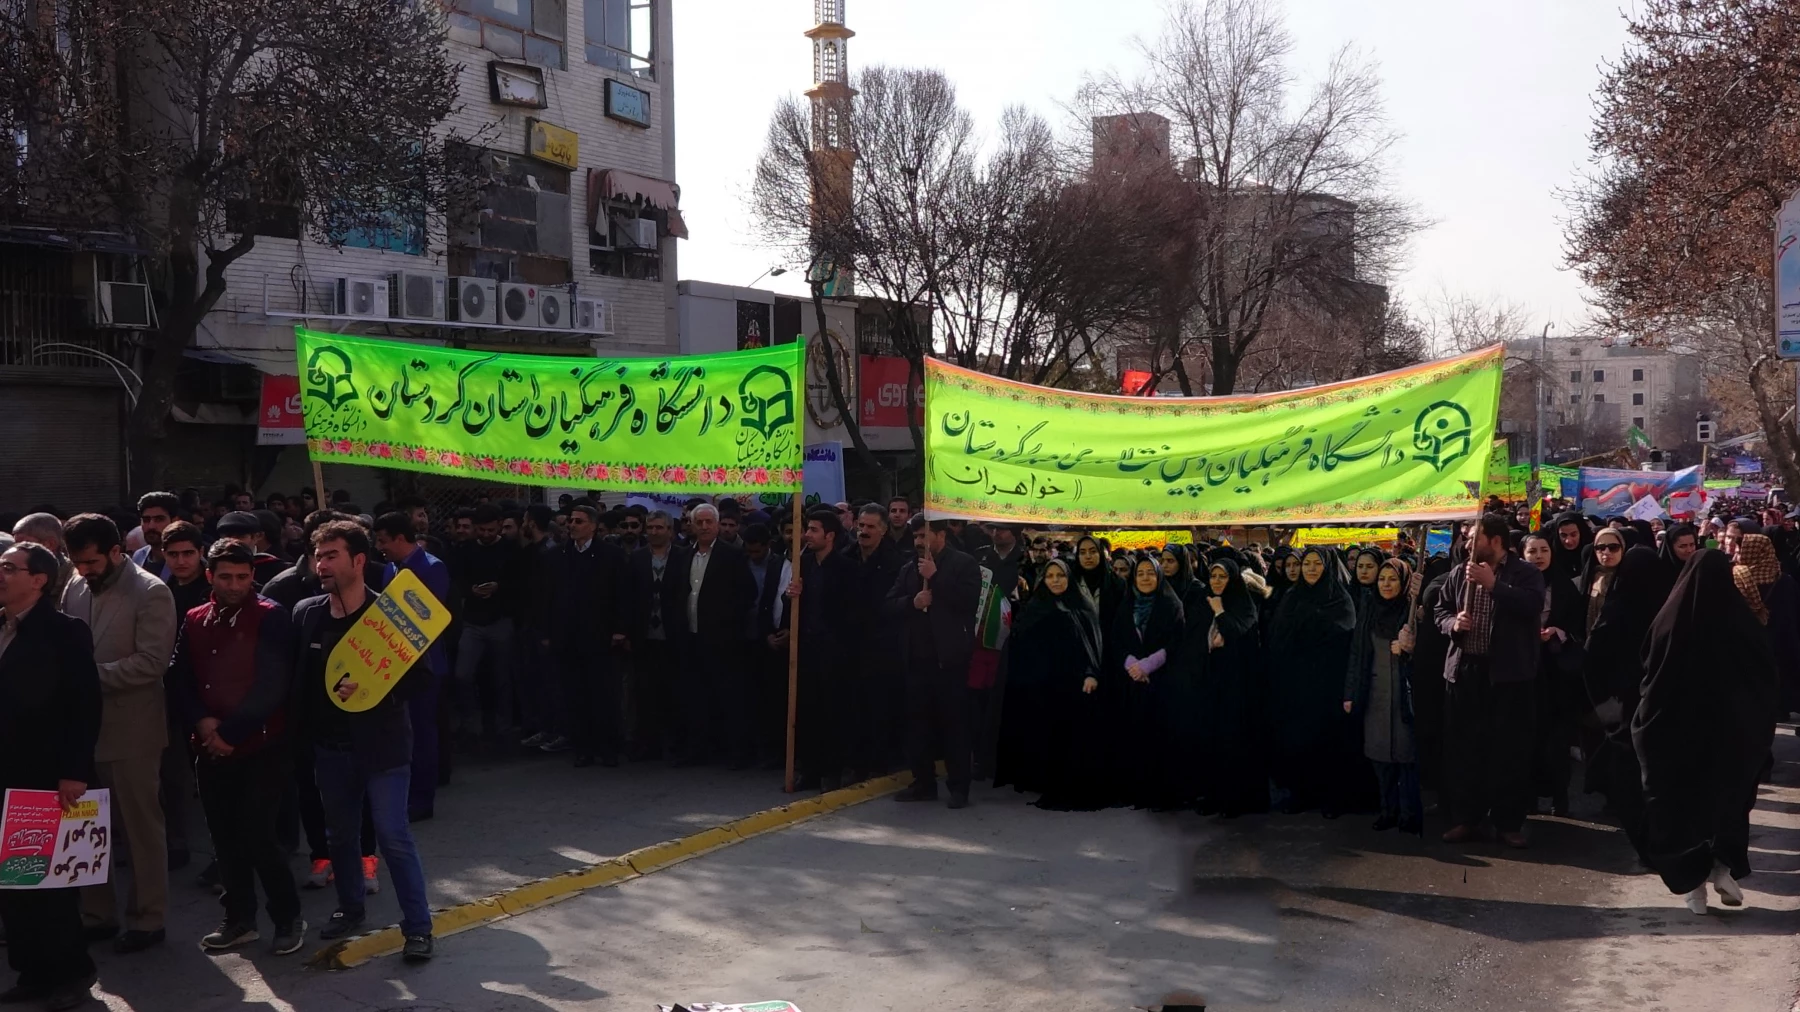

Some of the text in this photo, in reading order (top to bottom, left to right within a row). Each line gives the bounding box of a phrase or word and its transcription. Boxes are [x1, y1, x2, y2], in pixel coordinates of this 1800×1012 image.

[367, 353, 735, 455] دانشگاه فرهنگیان استان کردستان
[765, 429, 801, 462] دانشگاه
[1205, 426, 1313, 494] فرهنگیان
[1307, 404, 1405, 472] دانشگاه
[363, 616, 414, 665] انقلاب اسلامی
[63, 820, 106, 853] امریکا
[54, 852, 106, 884] مرگ بر
